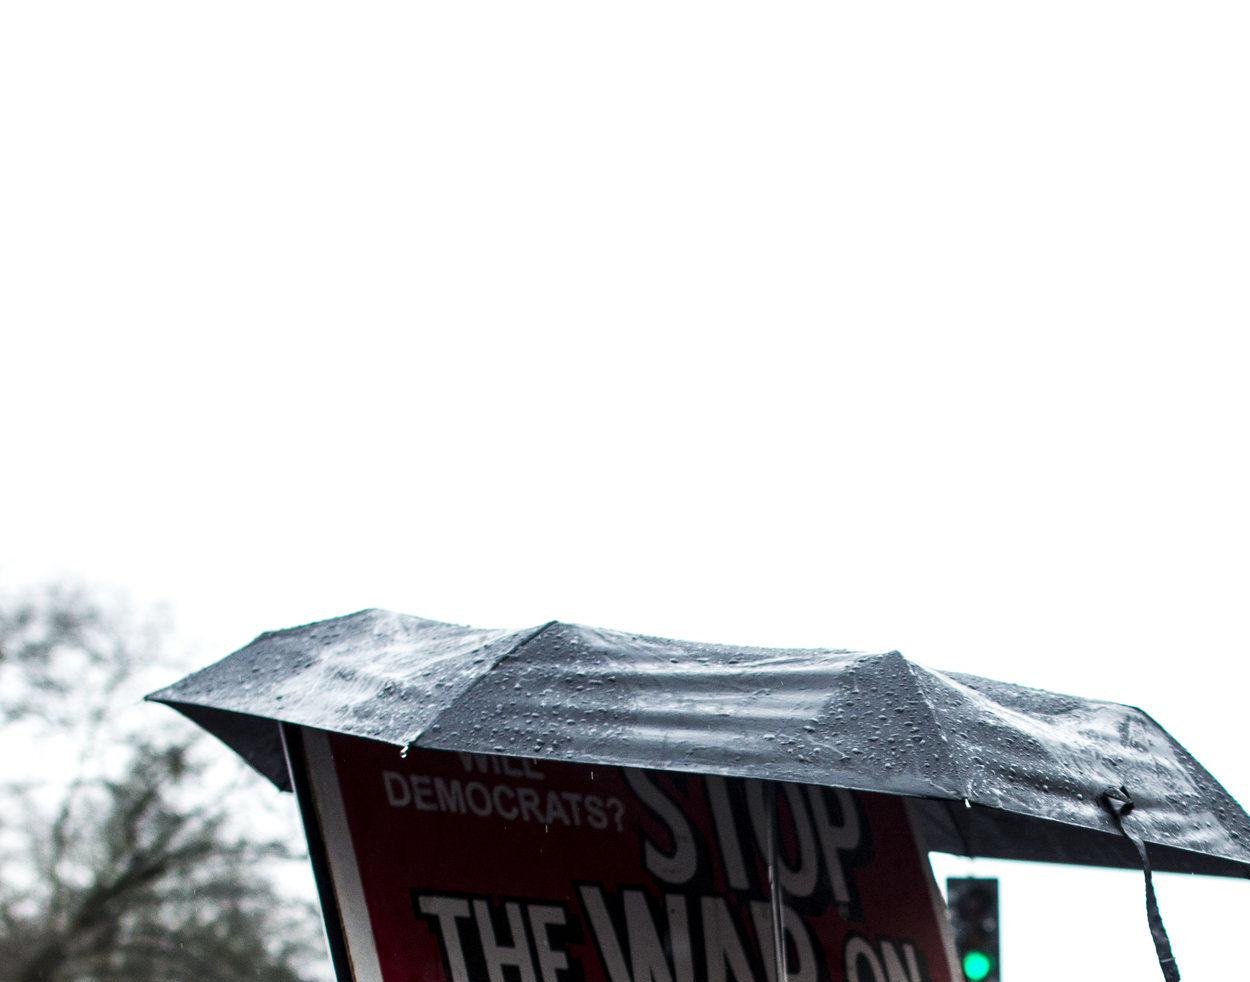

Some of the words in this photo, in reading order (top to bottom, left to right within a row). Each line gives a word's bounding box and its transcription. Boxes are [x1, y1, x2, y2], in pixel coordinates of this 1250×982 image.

[459, 752, 546, 781] WILL
[382, 771, 624, 830] DEMOCRATS?
[622, 767, 868, 905] STOP
